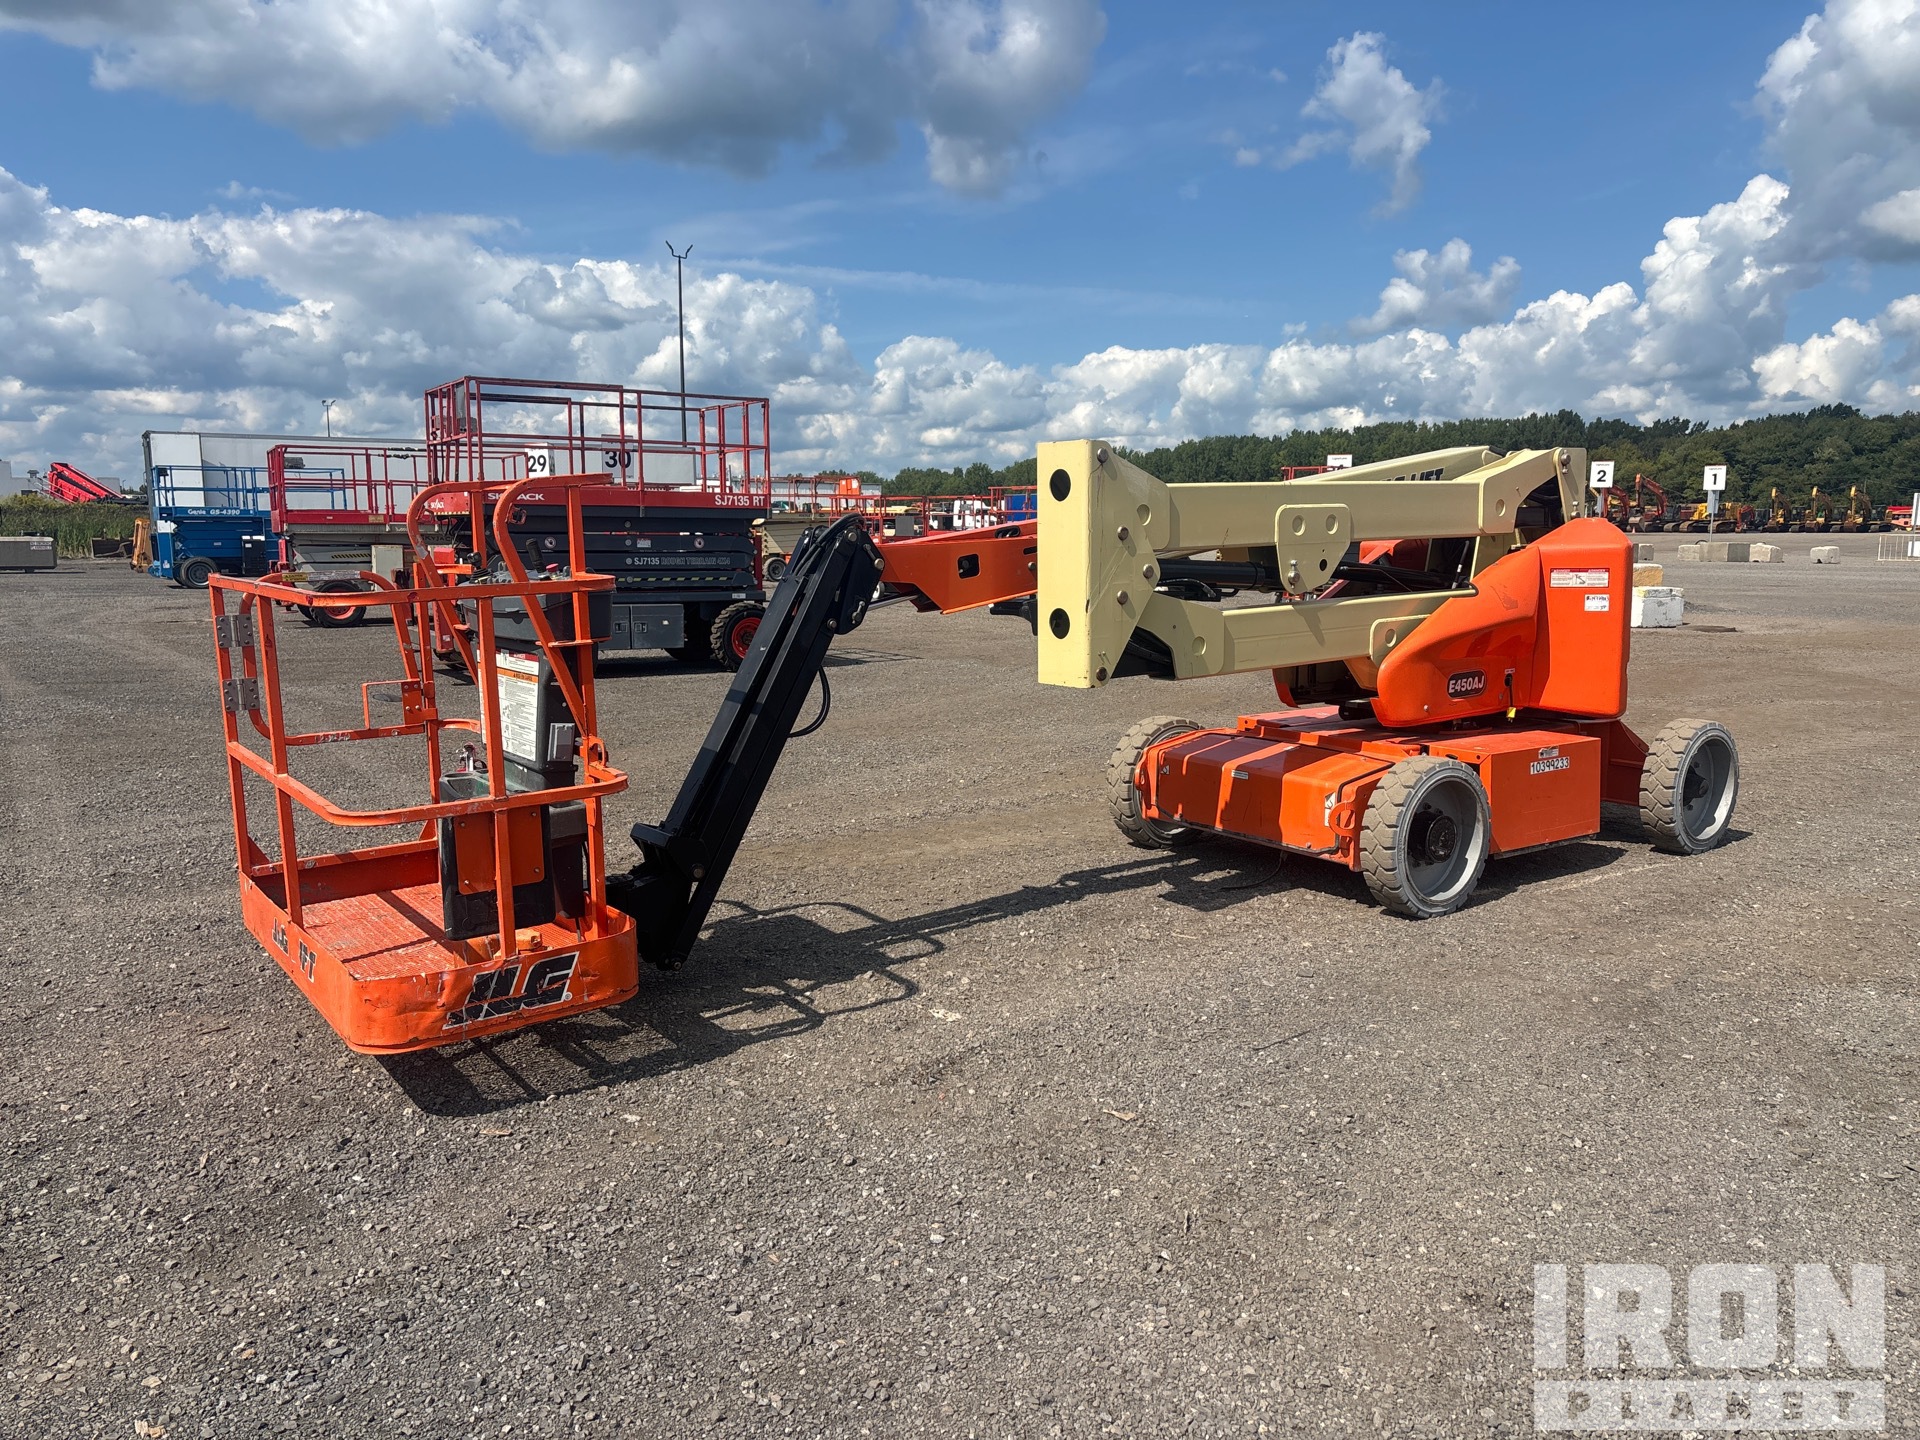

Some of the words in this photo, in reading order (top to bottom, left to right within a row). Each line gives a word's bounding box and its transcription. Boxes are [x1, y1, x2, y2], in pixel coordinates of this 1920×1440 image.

[527, 454, 547, 473] 29
[604, 450, 632, 469] 30
[1596, 469, 1607, 483] 2
[1711, 473, 1718, 486] 1
[487, 492, 545, 501] SKACK
[715, 494, 750, 507] SJ7135
[752, 495, 765, 507] RT
[209, 508, 241, 516] GS-4390
[633, 557, 660, 566] SJ7135
[1448, 675, 1485, 694] E450AJ
[1531, 757, 1569, 774] 10399233
